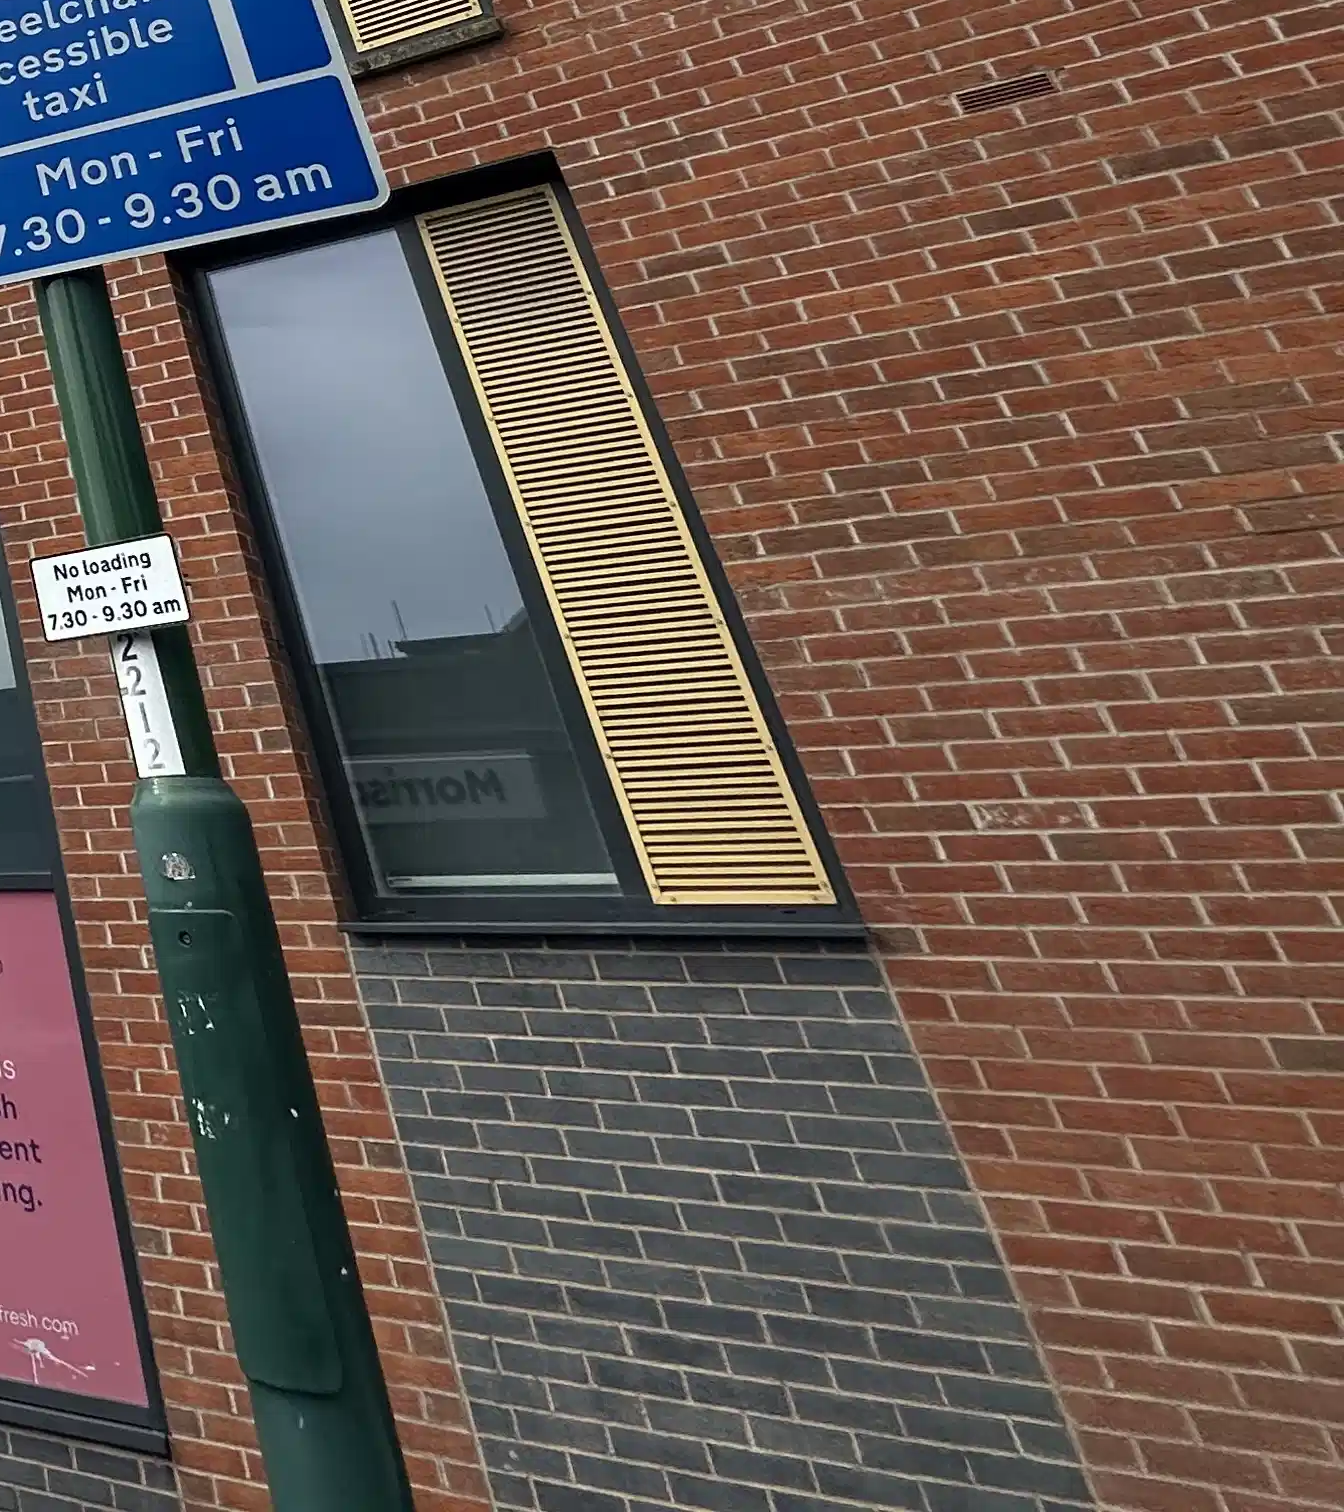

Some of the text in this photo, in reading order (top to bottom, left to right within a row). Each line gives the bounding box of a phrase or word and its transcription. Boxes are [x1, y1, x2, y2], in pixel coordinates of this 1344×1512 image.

[23, 71, 109, 122] taxi
[36, 148, 139, 197] Mon
[175, 117, 244, 164] Fri
[122, 173, 242, 230] 9.30
[253, 162, 333, 203] am
[53, 551, 153, 582] No loading
[66, 584, 108, 604] Mon
[120, 574, 149, 595] Fri
[101, 599, 148, 623] 9.30
[152, 598, 182, 615] am
